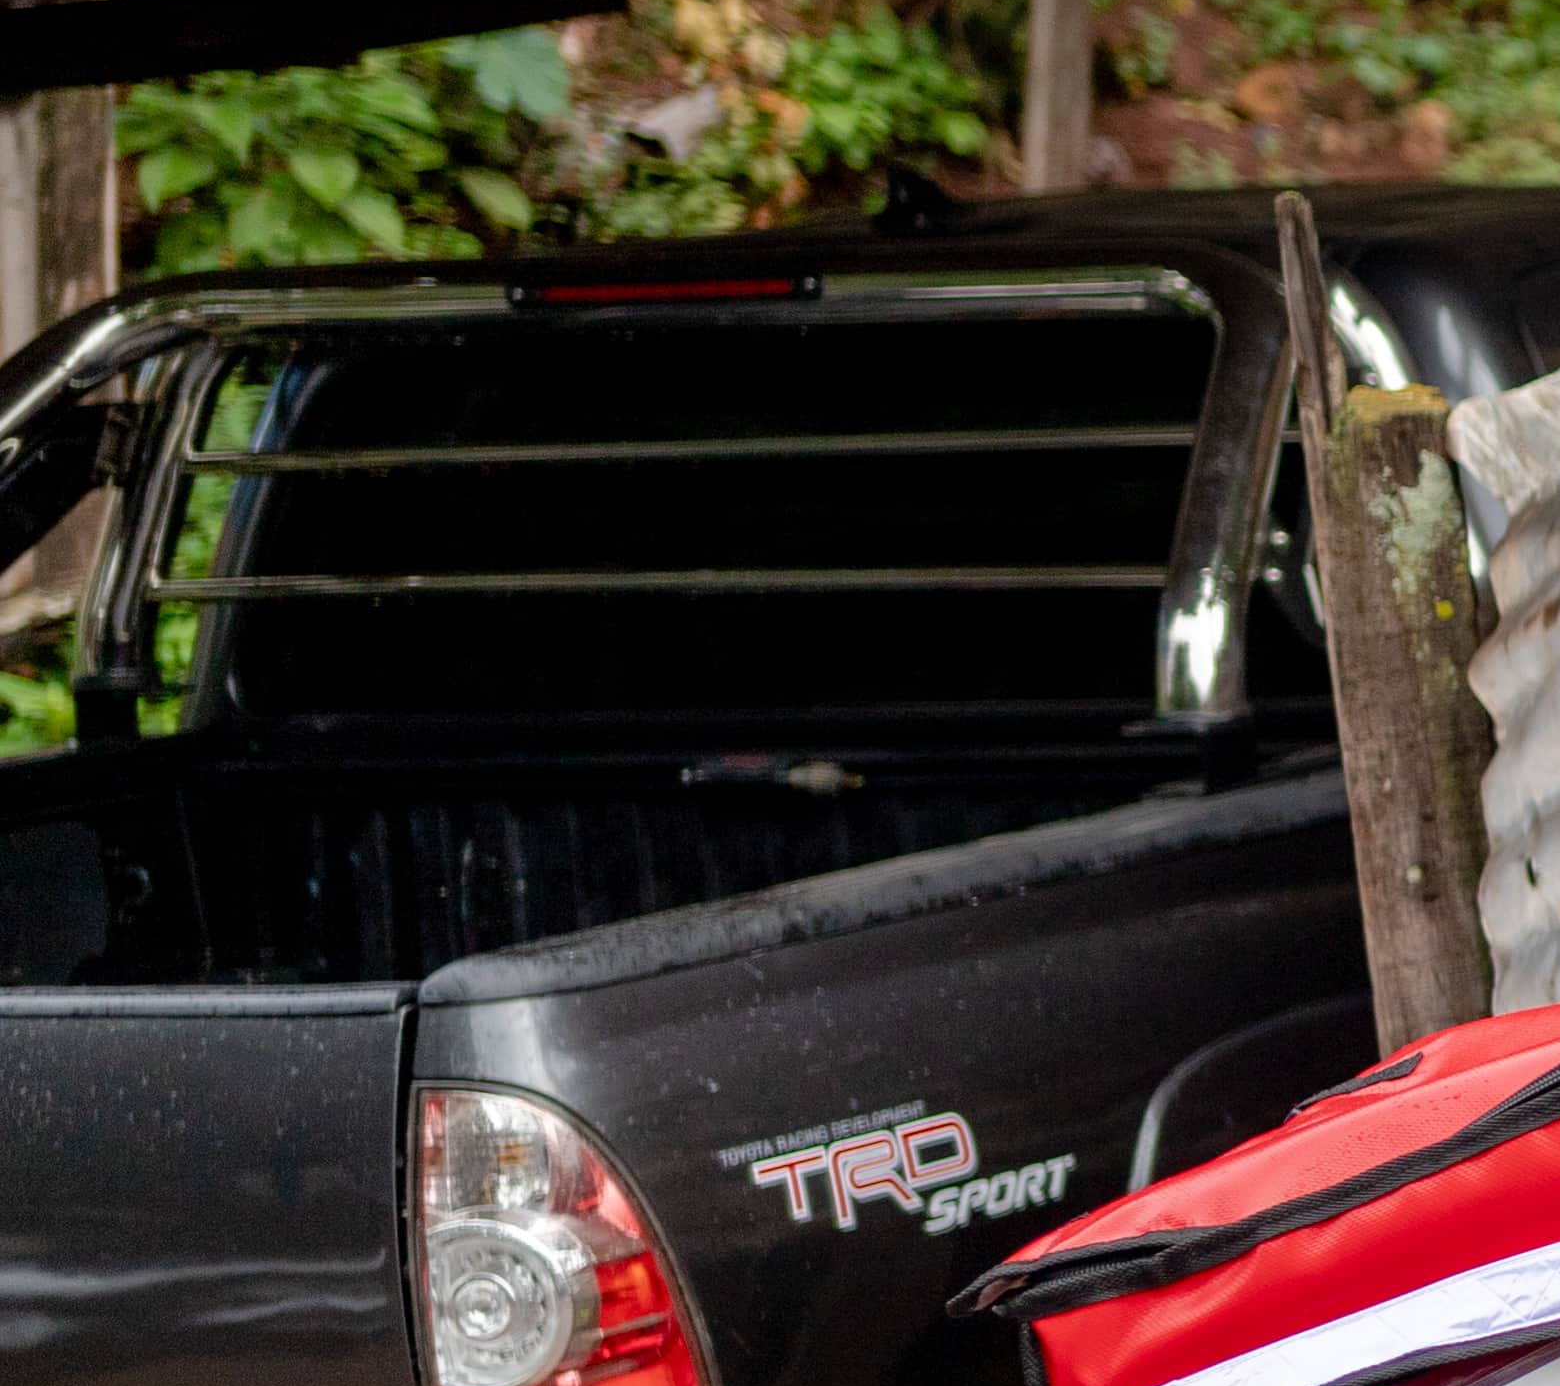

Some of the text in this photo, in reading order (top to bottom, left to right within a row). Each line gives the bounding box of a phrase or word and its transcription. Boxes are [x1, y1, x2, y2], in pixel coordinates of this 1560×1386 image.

[718, 1100, 925, 1168] TOYOTA RACING DEVELOPMENT
[752, 1112, 977, 1232] TRD
[924, 1155, 1074, 1236] SPORT
